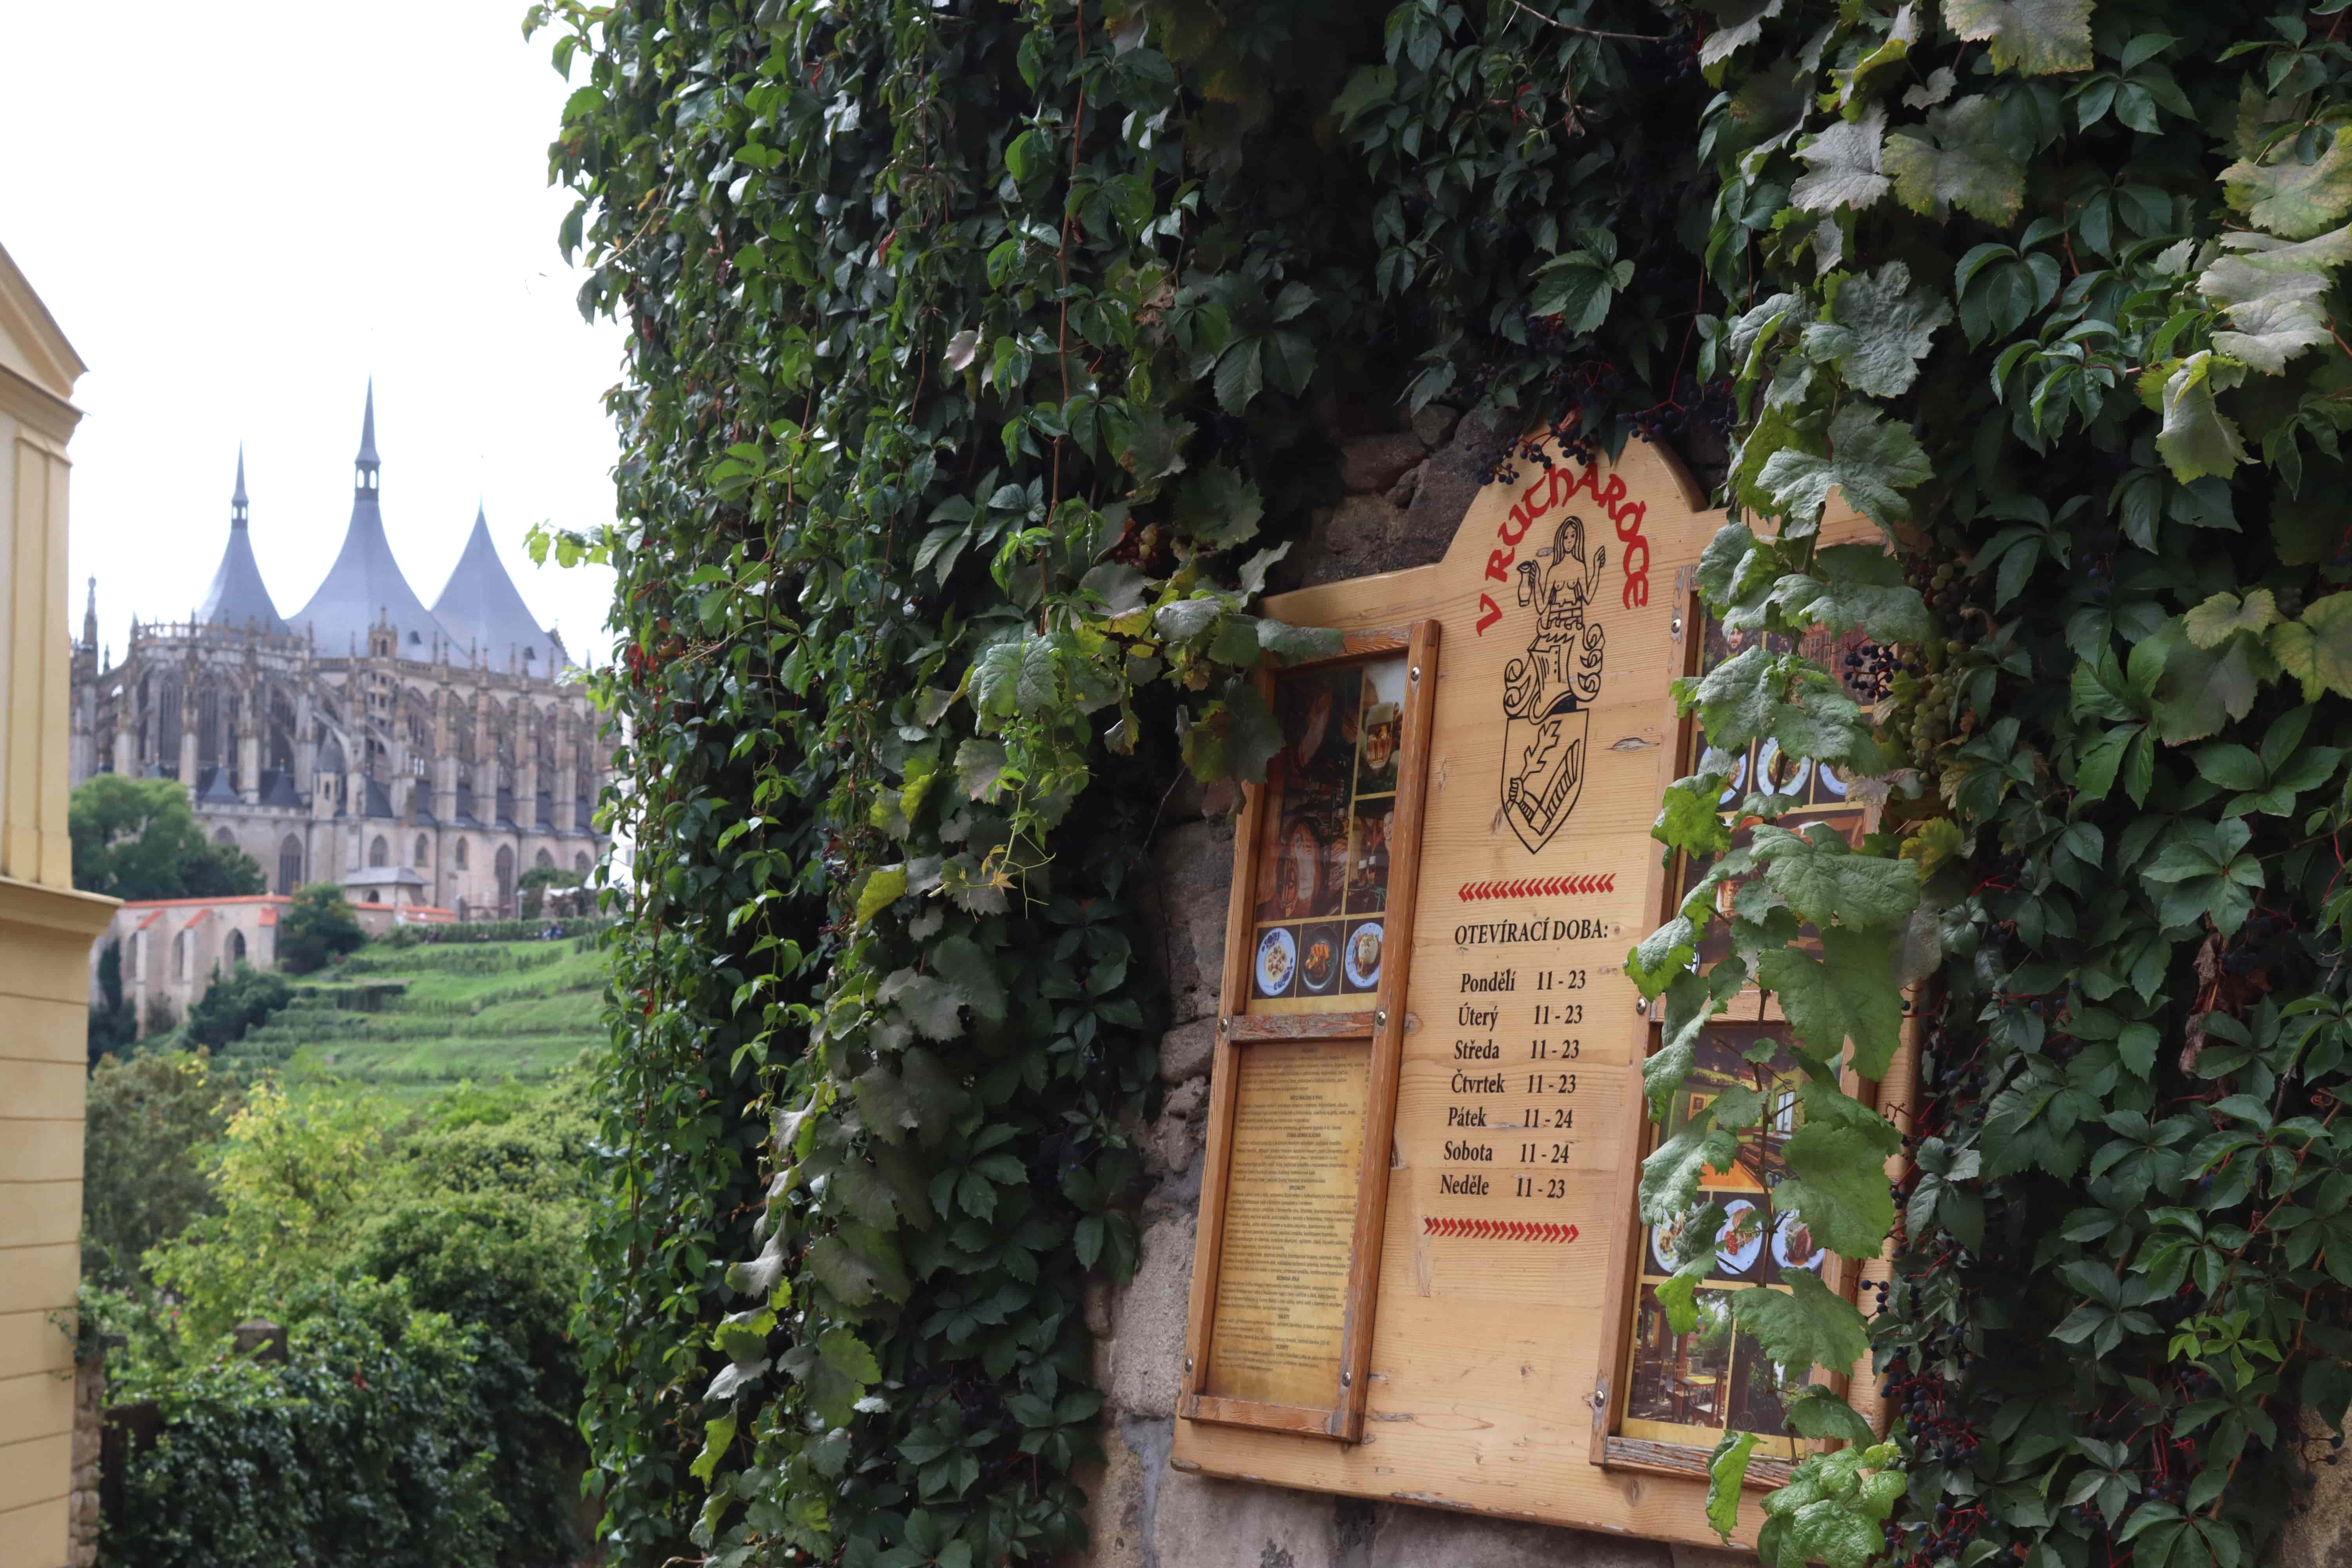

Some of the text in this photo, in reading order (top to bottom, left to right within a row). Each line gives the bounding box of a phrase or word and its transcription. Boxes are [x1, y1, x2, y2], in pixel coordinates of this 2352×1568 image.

[1476, 593, 1503, 637] V
[1455, 917, 1608, 945] OTEVÍRACÍ DOBA:
[1461, 969, 1515, 993] Pondělí
[1537, 971, 1552, 990] 11
[1568, 970, 1585, 989] 23
[1459, 1002, 1498, 1031] Úterý
[1535, 1005, 1549, 1024] 11
[1564, 1005, 1582, 1024] 23
[1454, 1039, 1499, 1059] Středa
[1531, 1040, 1546, 1059] 11
[1561, 1040, 1579, 1059] 23
[1452, 1069, 1505, 1093] Čtvrtek
[1528, 1074, 1542, 1093] 11
[1558, 1074, 1575, 1093] 23
[1448, 1107, 1486, 1127] Pátek
[1524, 1109, 1539, 1128] 11
[1554, 1109, 1572, 1128] 24
[1444, 1140, 1492, 1161] Sobota
[1521, 1143, 1535, 1162] 11
[1551, 1144, 1568, 1163] 24
[1440, 1174, 1489, 1195] Neděle
[1517, 1178, 1531, 1197] 11
[1547, 1179, 1564, 1198] 23
